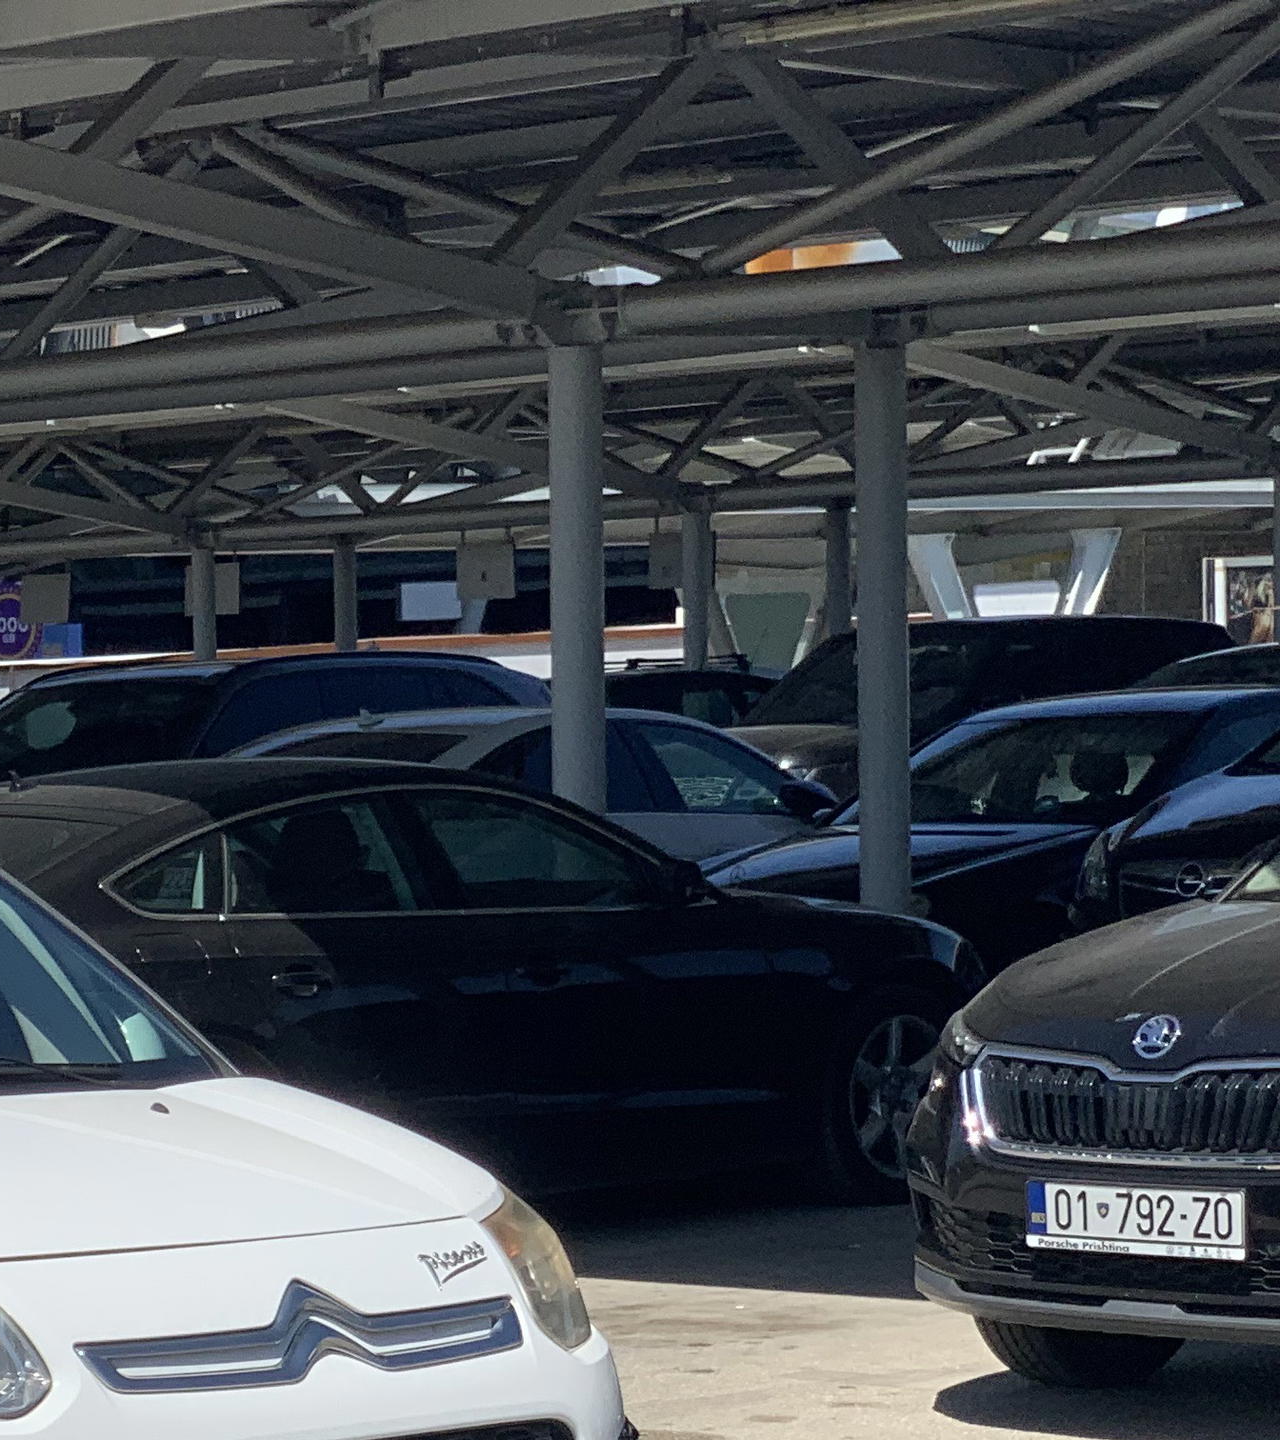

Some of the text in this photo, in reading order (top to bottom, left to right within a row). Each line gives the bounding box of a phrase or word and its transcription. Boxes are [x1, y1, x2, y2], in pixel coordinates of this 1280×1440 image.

[1054, 1188, 1089, 1232] 01
[1037, 1238, 1130, 1253] Porsche Prishtina
